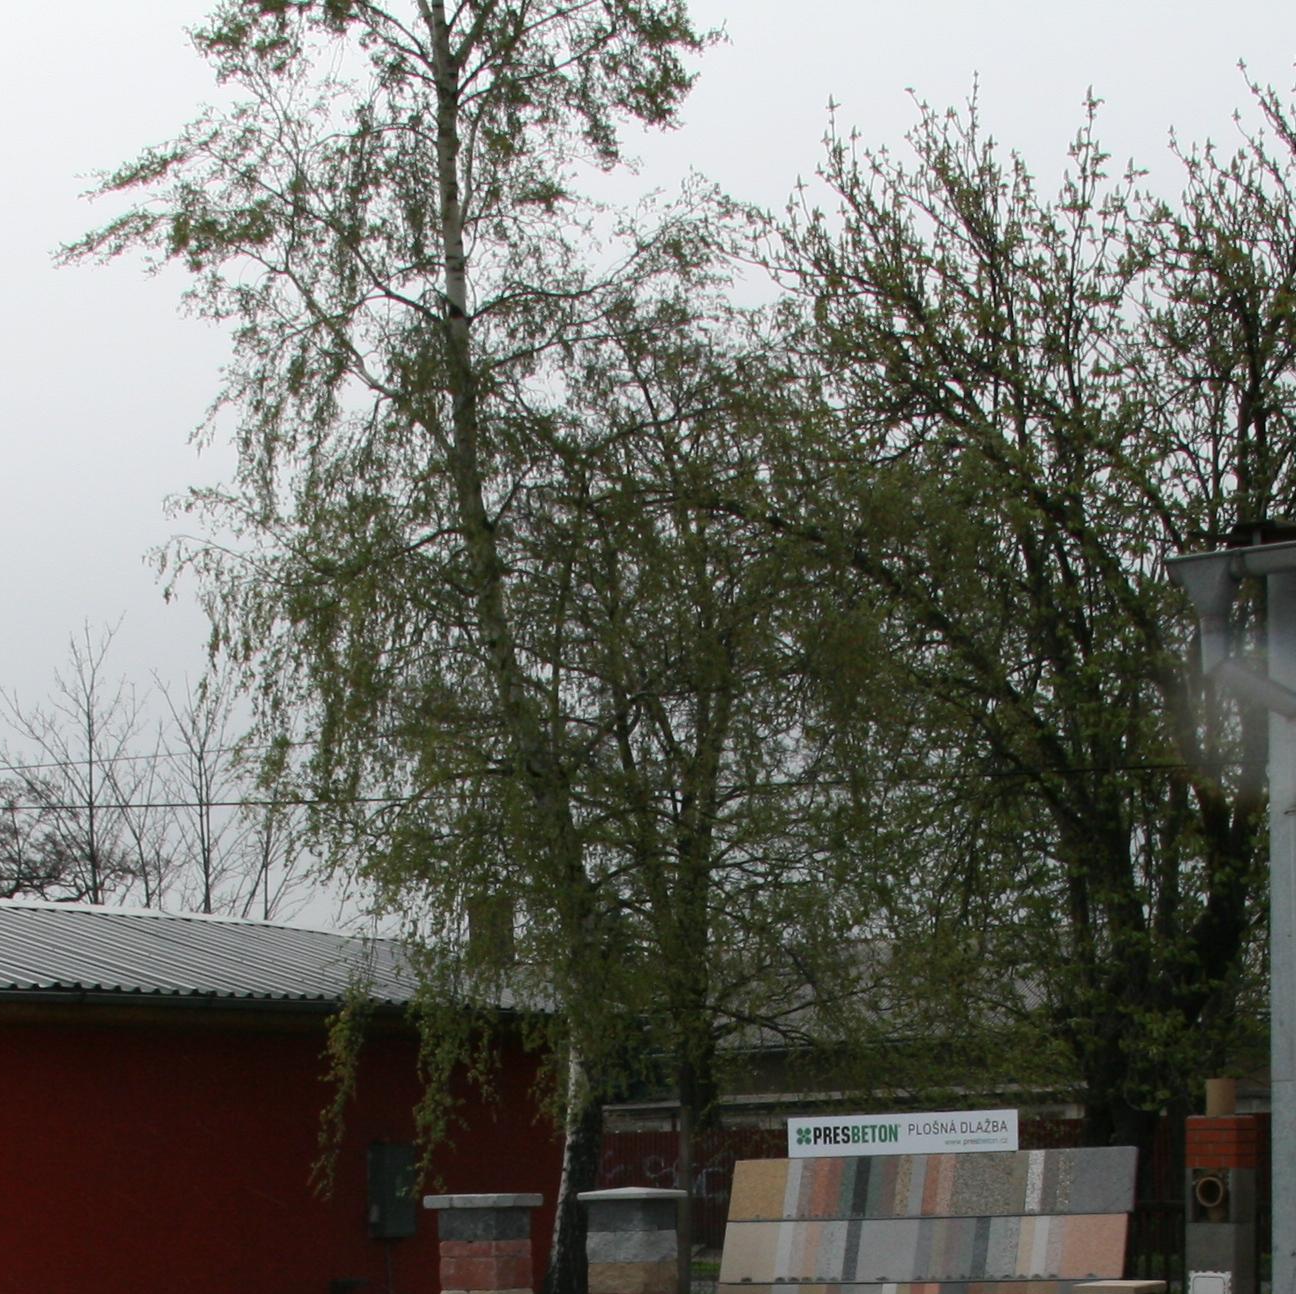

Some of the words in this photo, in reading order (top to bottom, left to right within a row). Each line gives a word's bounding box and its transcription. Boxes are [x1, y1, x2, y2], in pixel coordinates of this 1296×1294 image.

[813, 1124, 899, 1145] PRESBETON
[908, 1120, 957, 1136] PLOŠNÁ
[960, 1118, 1008, 1135] DLAŽBA
